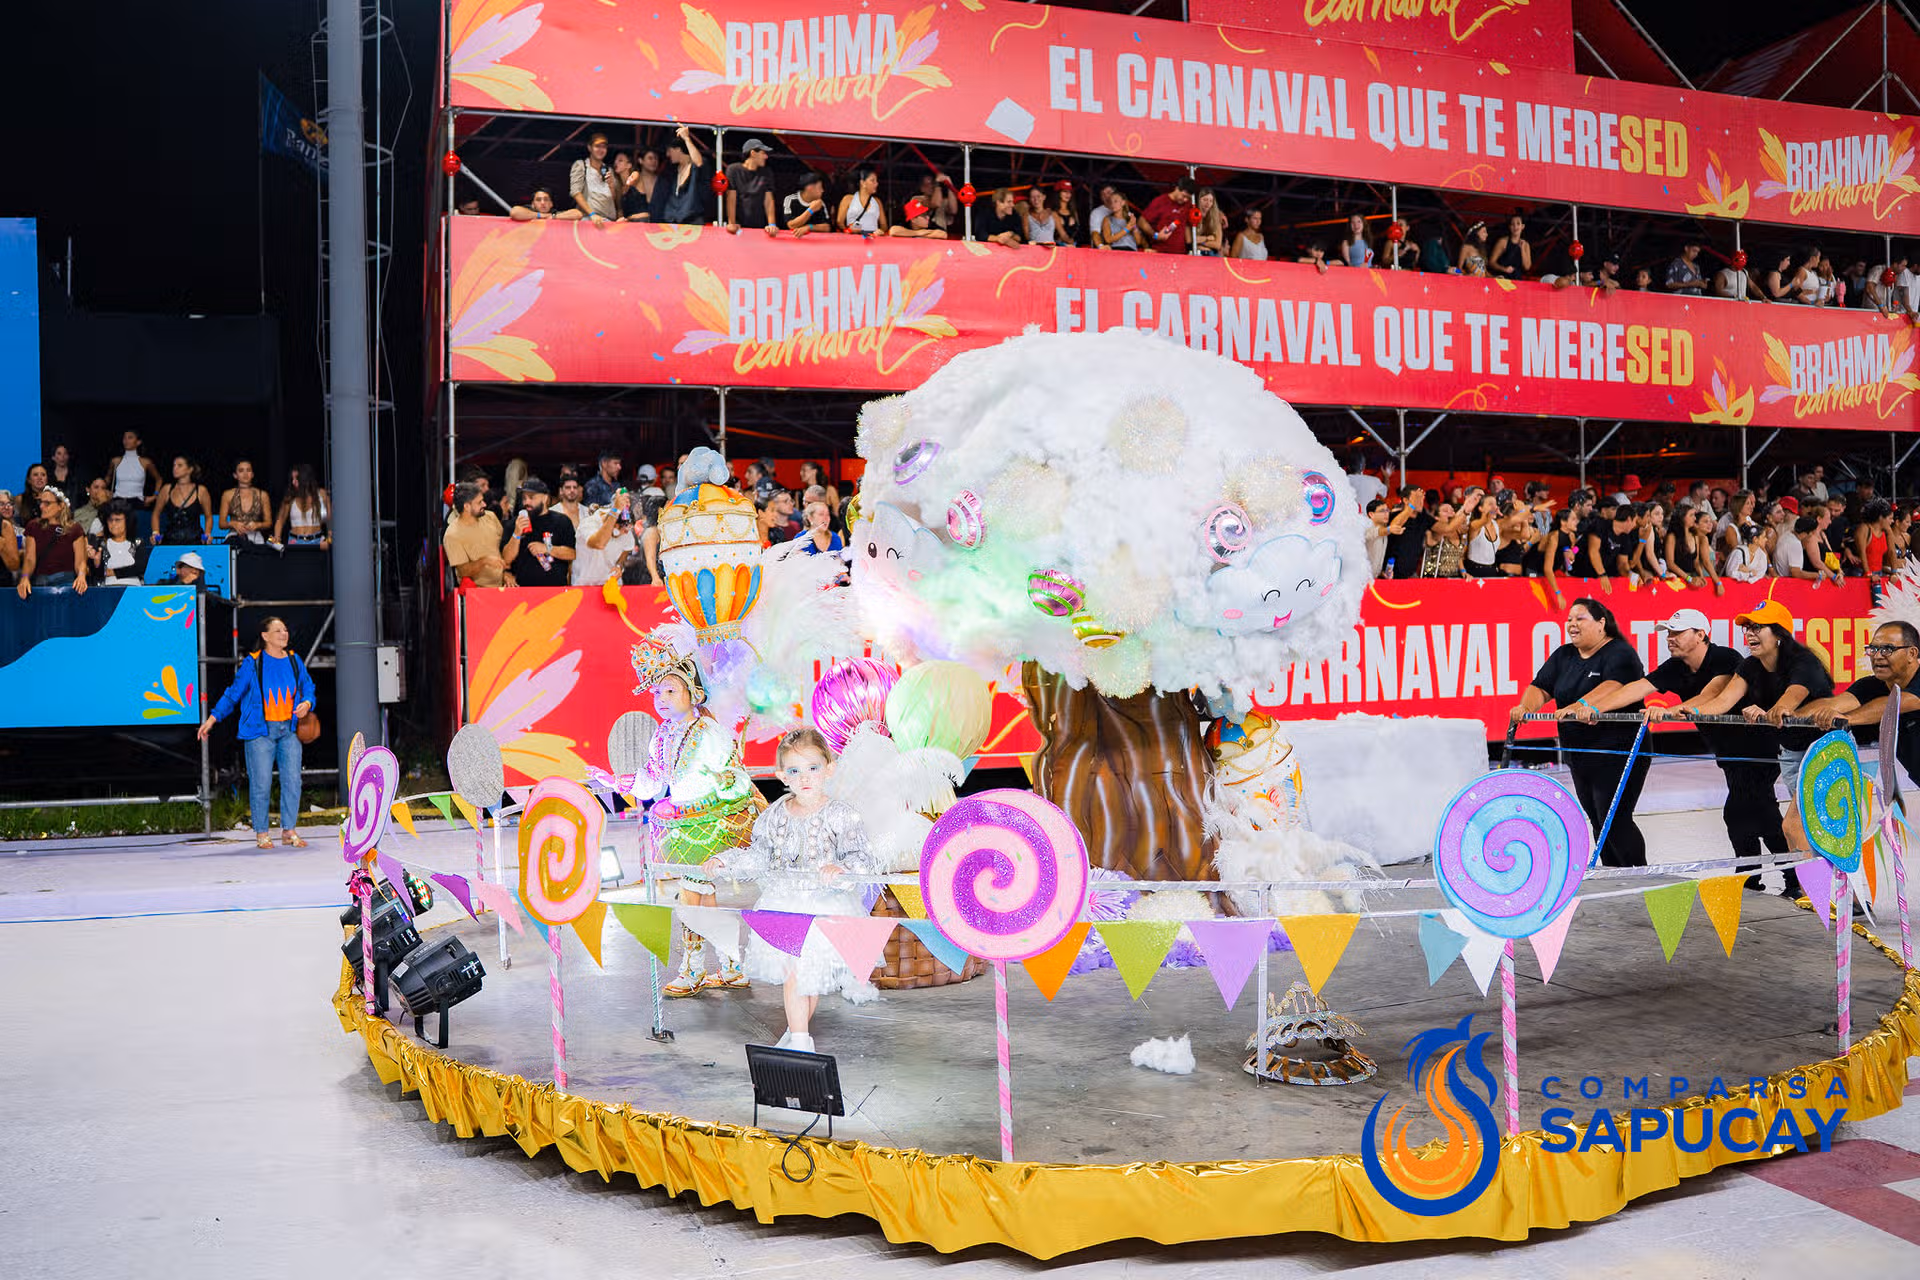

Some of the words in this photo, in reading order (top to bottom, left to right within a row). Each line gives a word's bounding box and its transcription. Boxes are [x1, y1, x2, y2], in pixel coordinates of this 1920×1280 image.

[725, 13, 900, 87] BRAHMA
[1049, 45, 1104, 114] EL
[1117, 53, 1356, 140] CARNAVAL
[1367, 82, 1449, 152] QUE
[1459, 93, 1505, 158] TE
[1516, 101, 1688, 177] MERESED
[1786, 134, 1892, 193] BRAHMA
[729, 264, 906, 344] BRAHMA
[1122, 291, 1361, 366] CARNAVAL
[1373, 306, 1454, 376] QUE
[1464, 312, 1510, 375] TE
[1521, 317, 1695, 387] MERESED
[1790, 334, 1893, 396] BRAHMA
